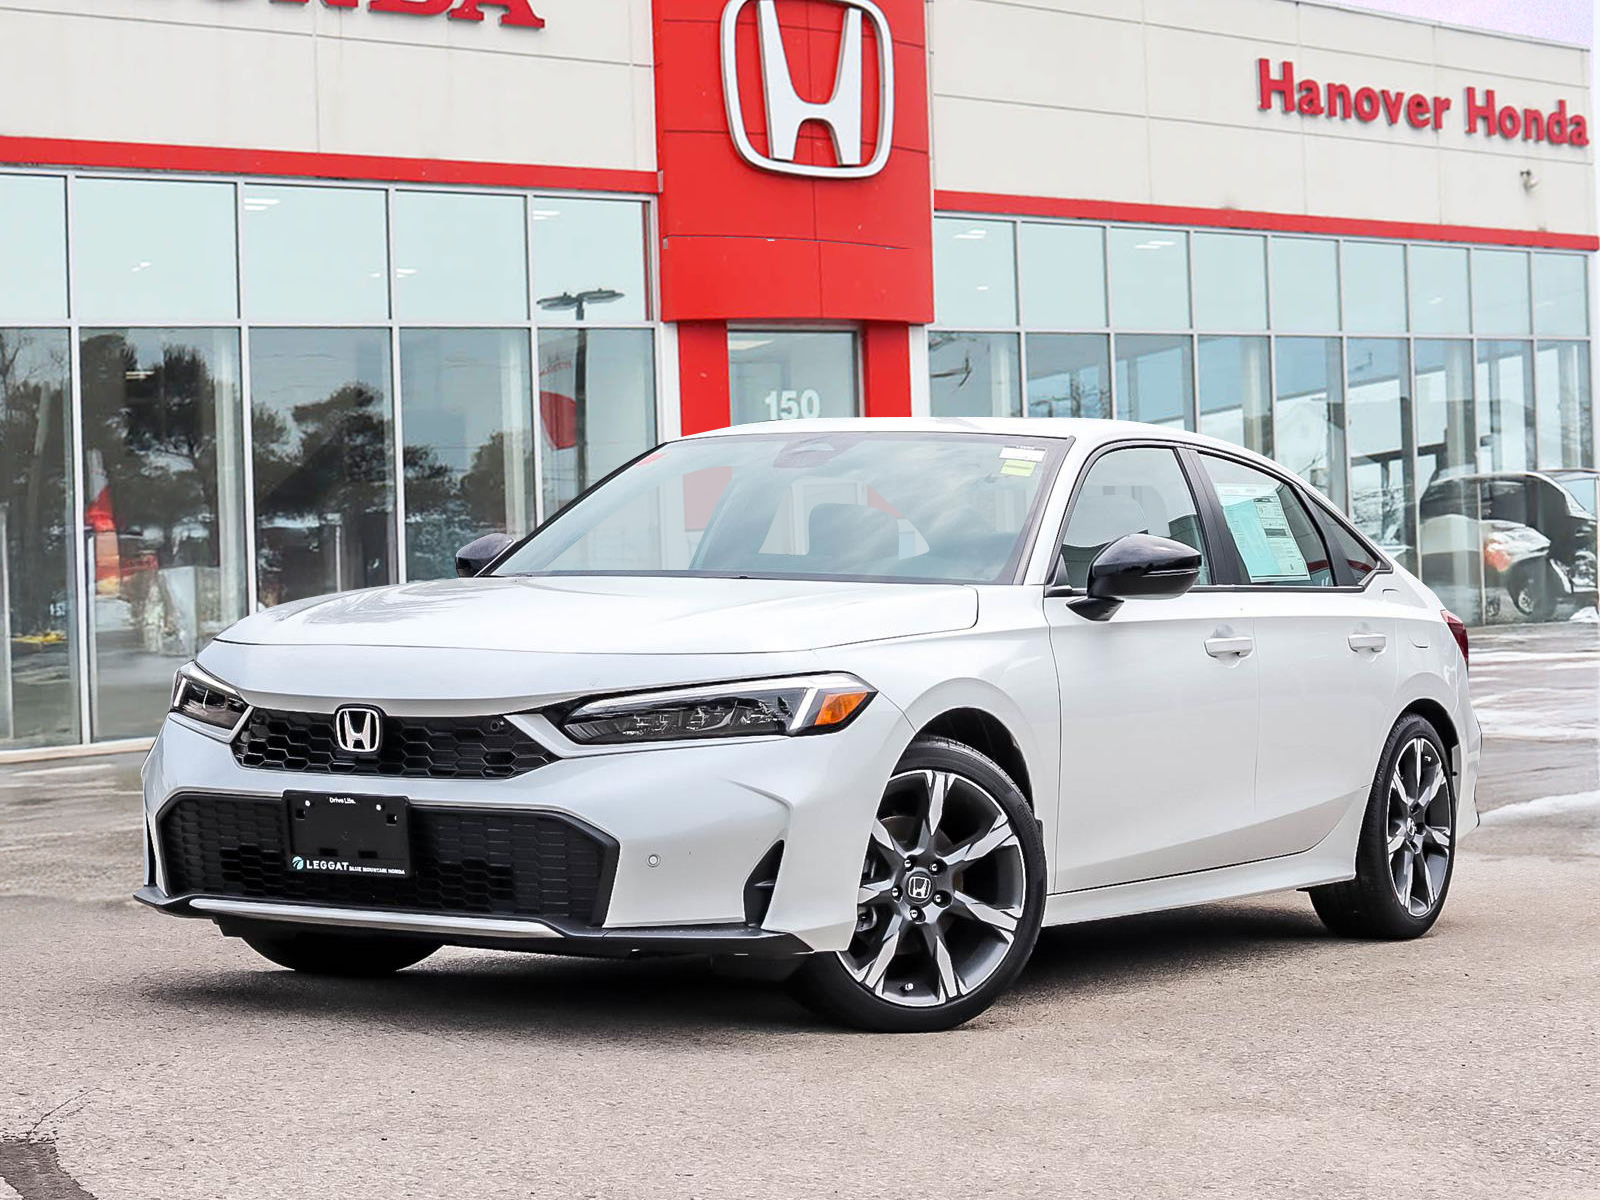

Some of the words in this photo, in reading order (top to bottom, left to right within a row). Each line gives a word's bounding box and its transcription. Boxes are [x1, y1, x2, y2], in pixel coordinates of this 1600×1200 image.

[1257, 58, 1452, 130] Hanover
[1465, 86, 1589, 147] Honda
[764, 388, 820, 420] 150
[306, 860, 349, 871] LEGGAT
